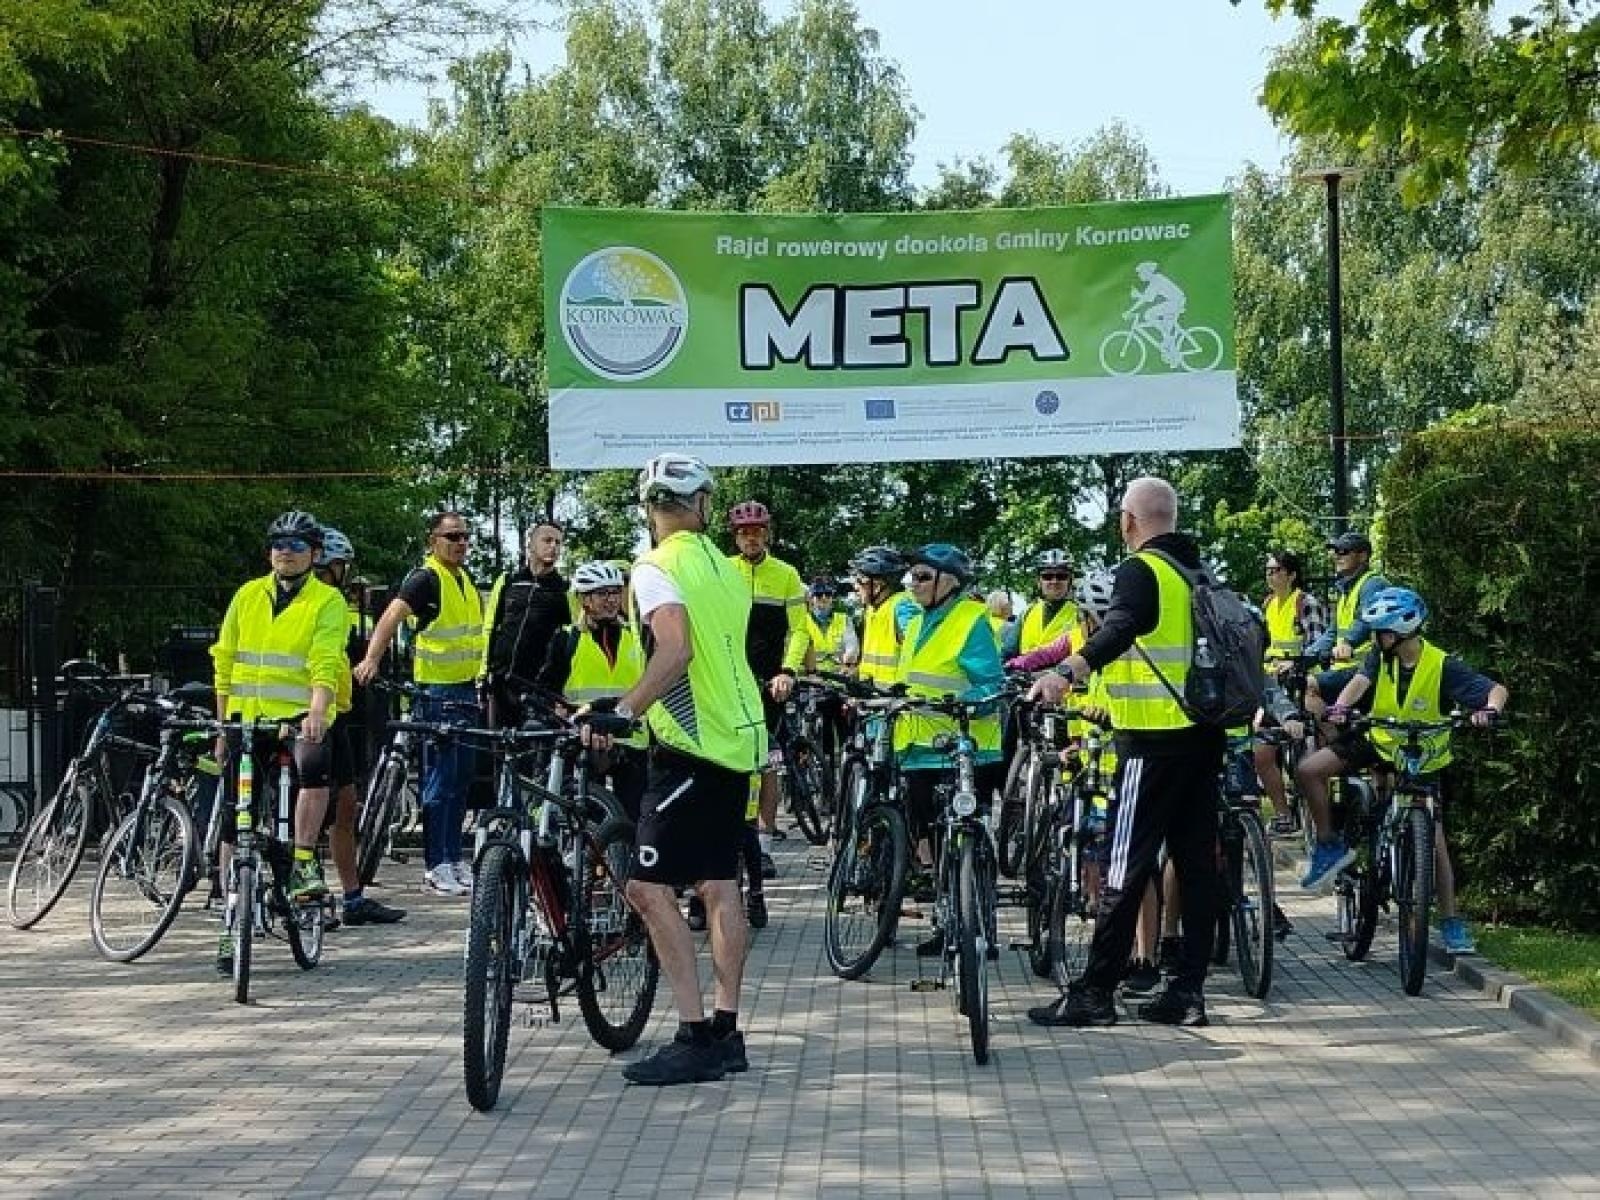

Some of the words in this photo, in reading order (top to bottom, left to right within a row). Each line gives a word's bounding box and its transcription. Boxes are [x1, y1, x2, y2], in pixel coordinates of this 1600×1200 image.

[716, 235, 769, 259] Rajd
[776, 237, 888, 260] rowerowy
[996, 229, 1070, 251] Gminy
[1076, 222, 1191, 246] Kornowac
[565, 307, 682, 324] KORNOWAC
[738, 276, 1070, 371] META
